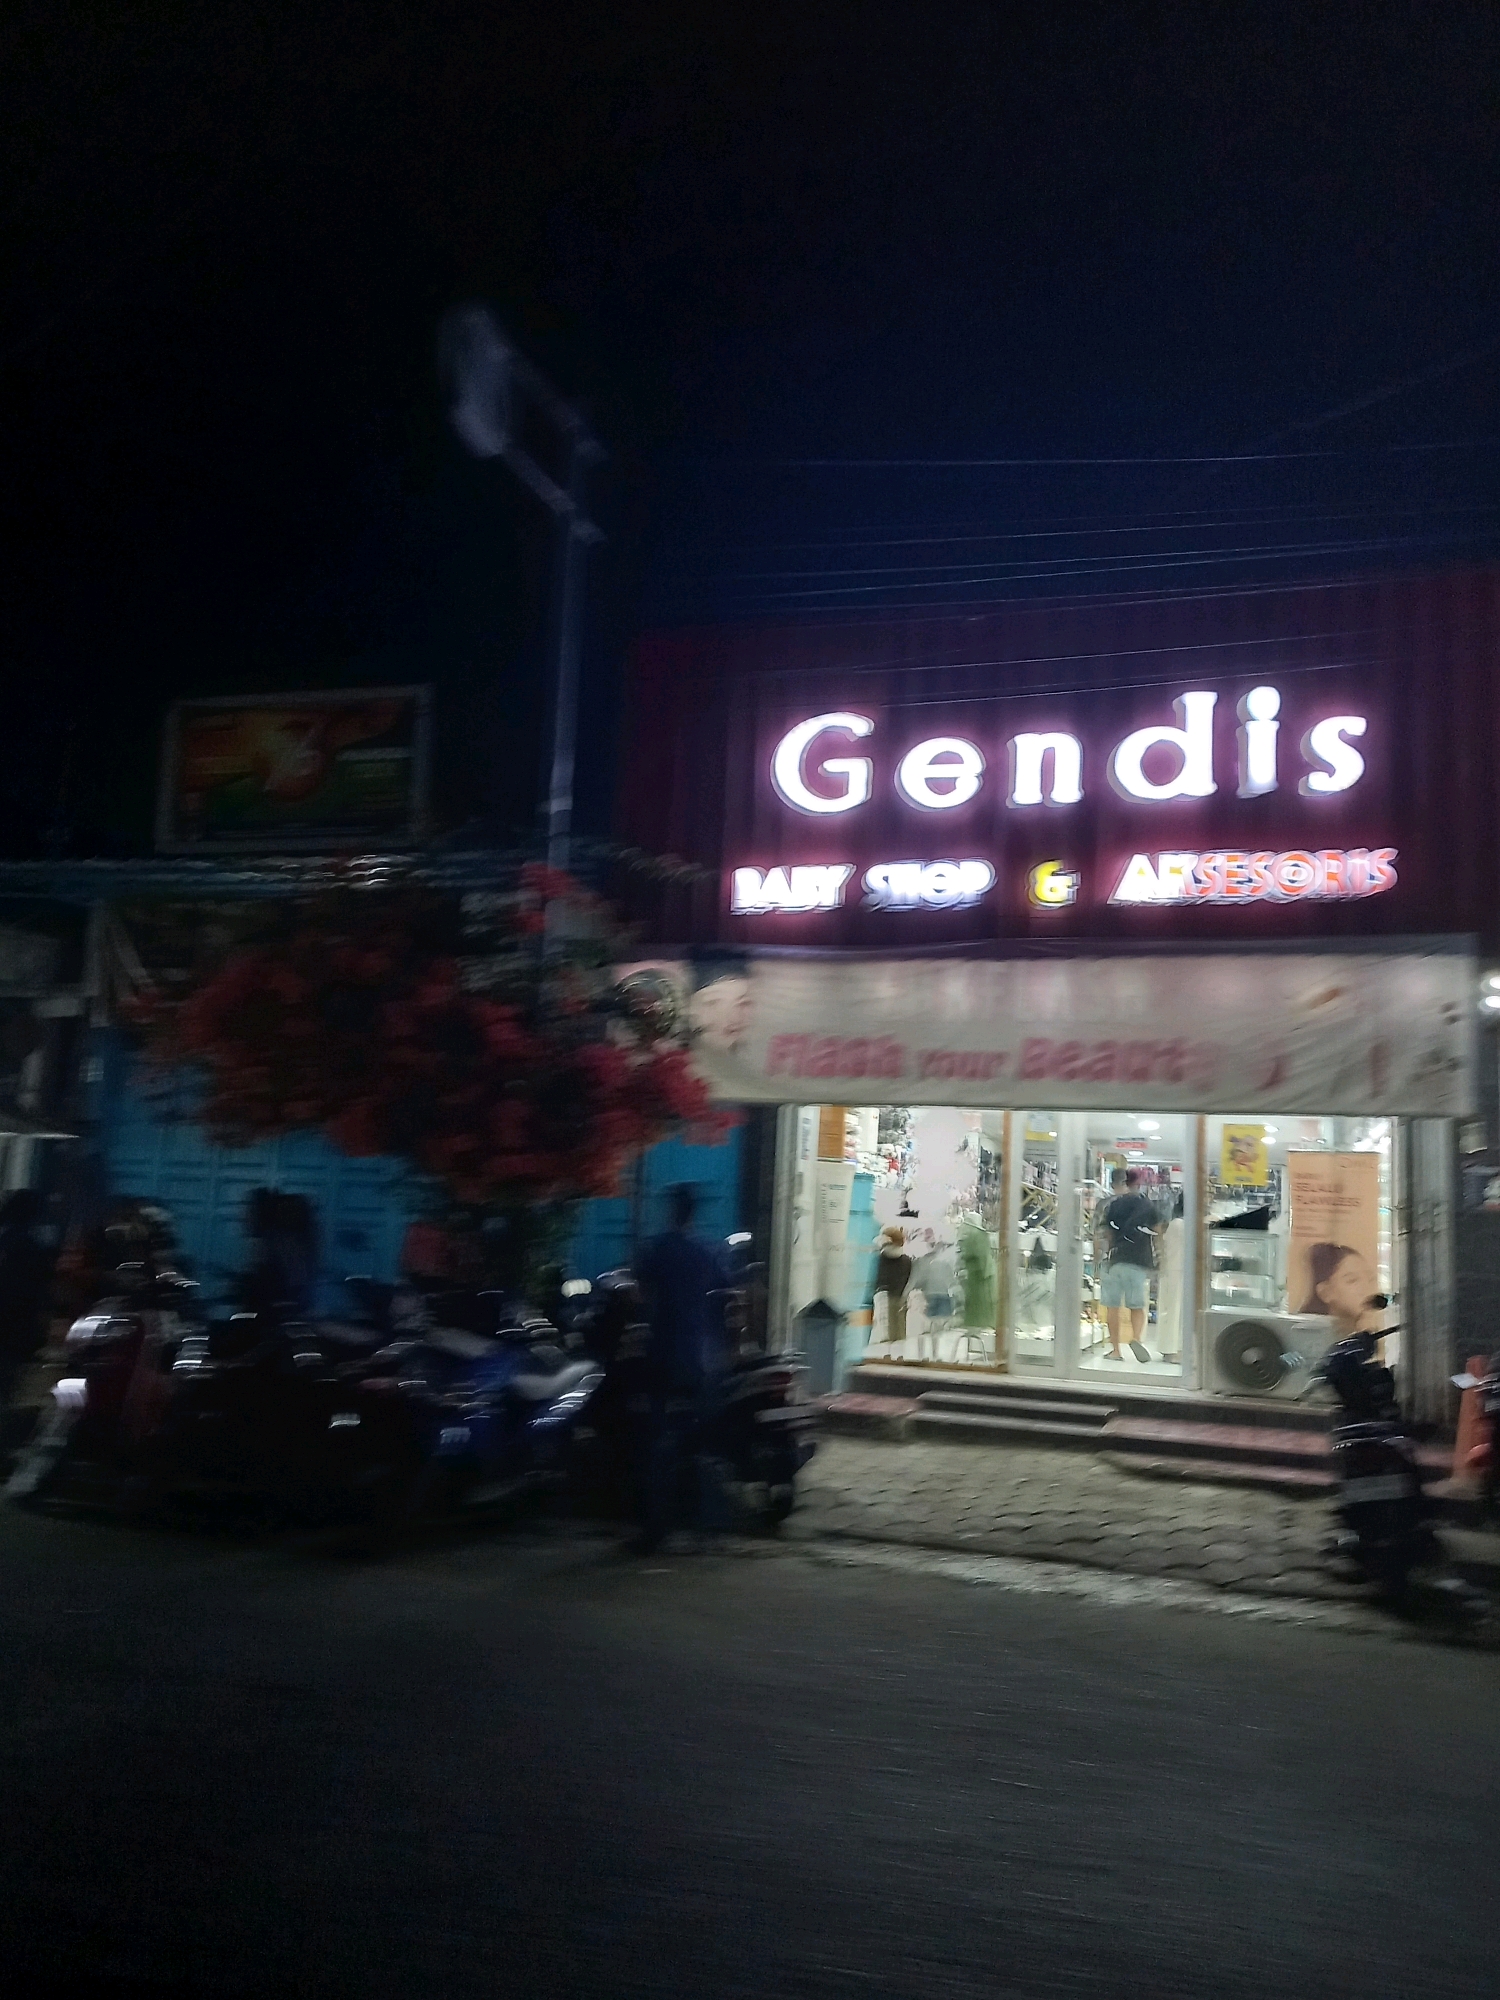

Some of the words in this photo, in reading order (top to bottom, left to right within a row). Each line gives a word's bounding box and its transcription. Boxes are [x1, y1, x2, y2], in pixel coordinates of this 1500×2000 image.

[771, 686, 1367, 816] Gendis
[731, 863, 856, 915] BABY
[861, 857, 997, 913] SHOP
